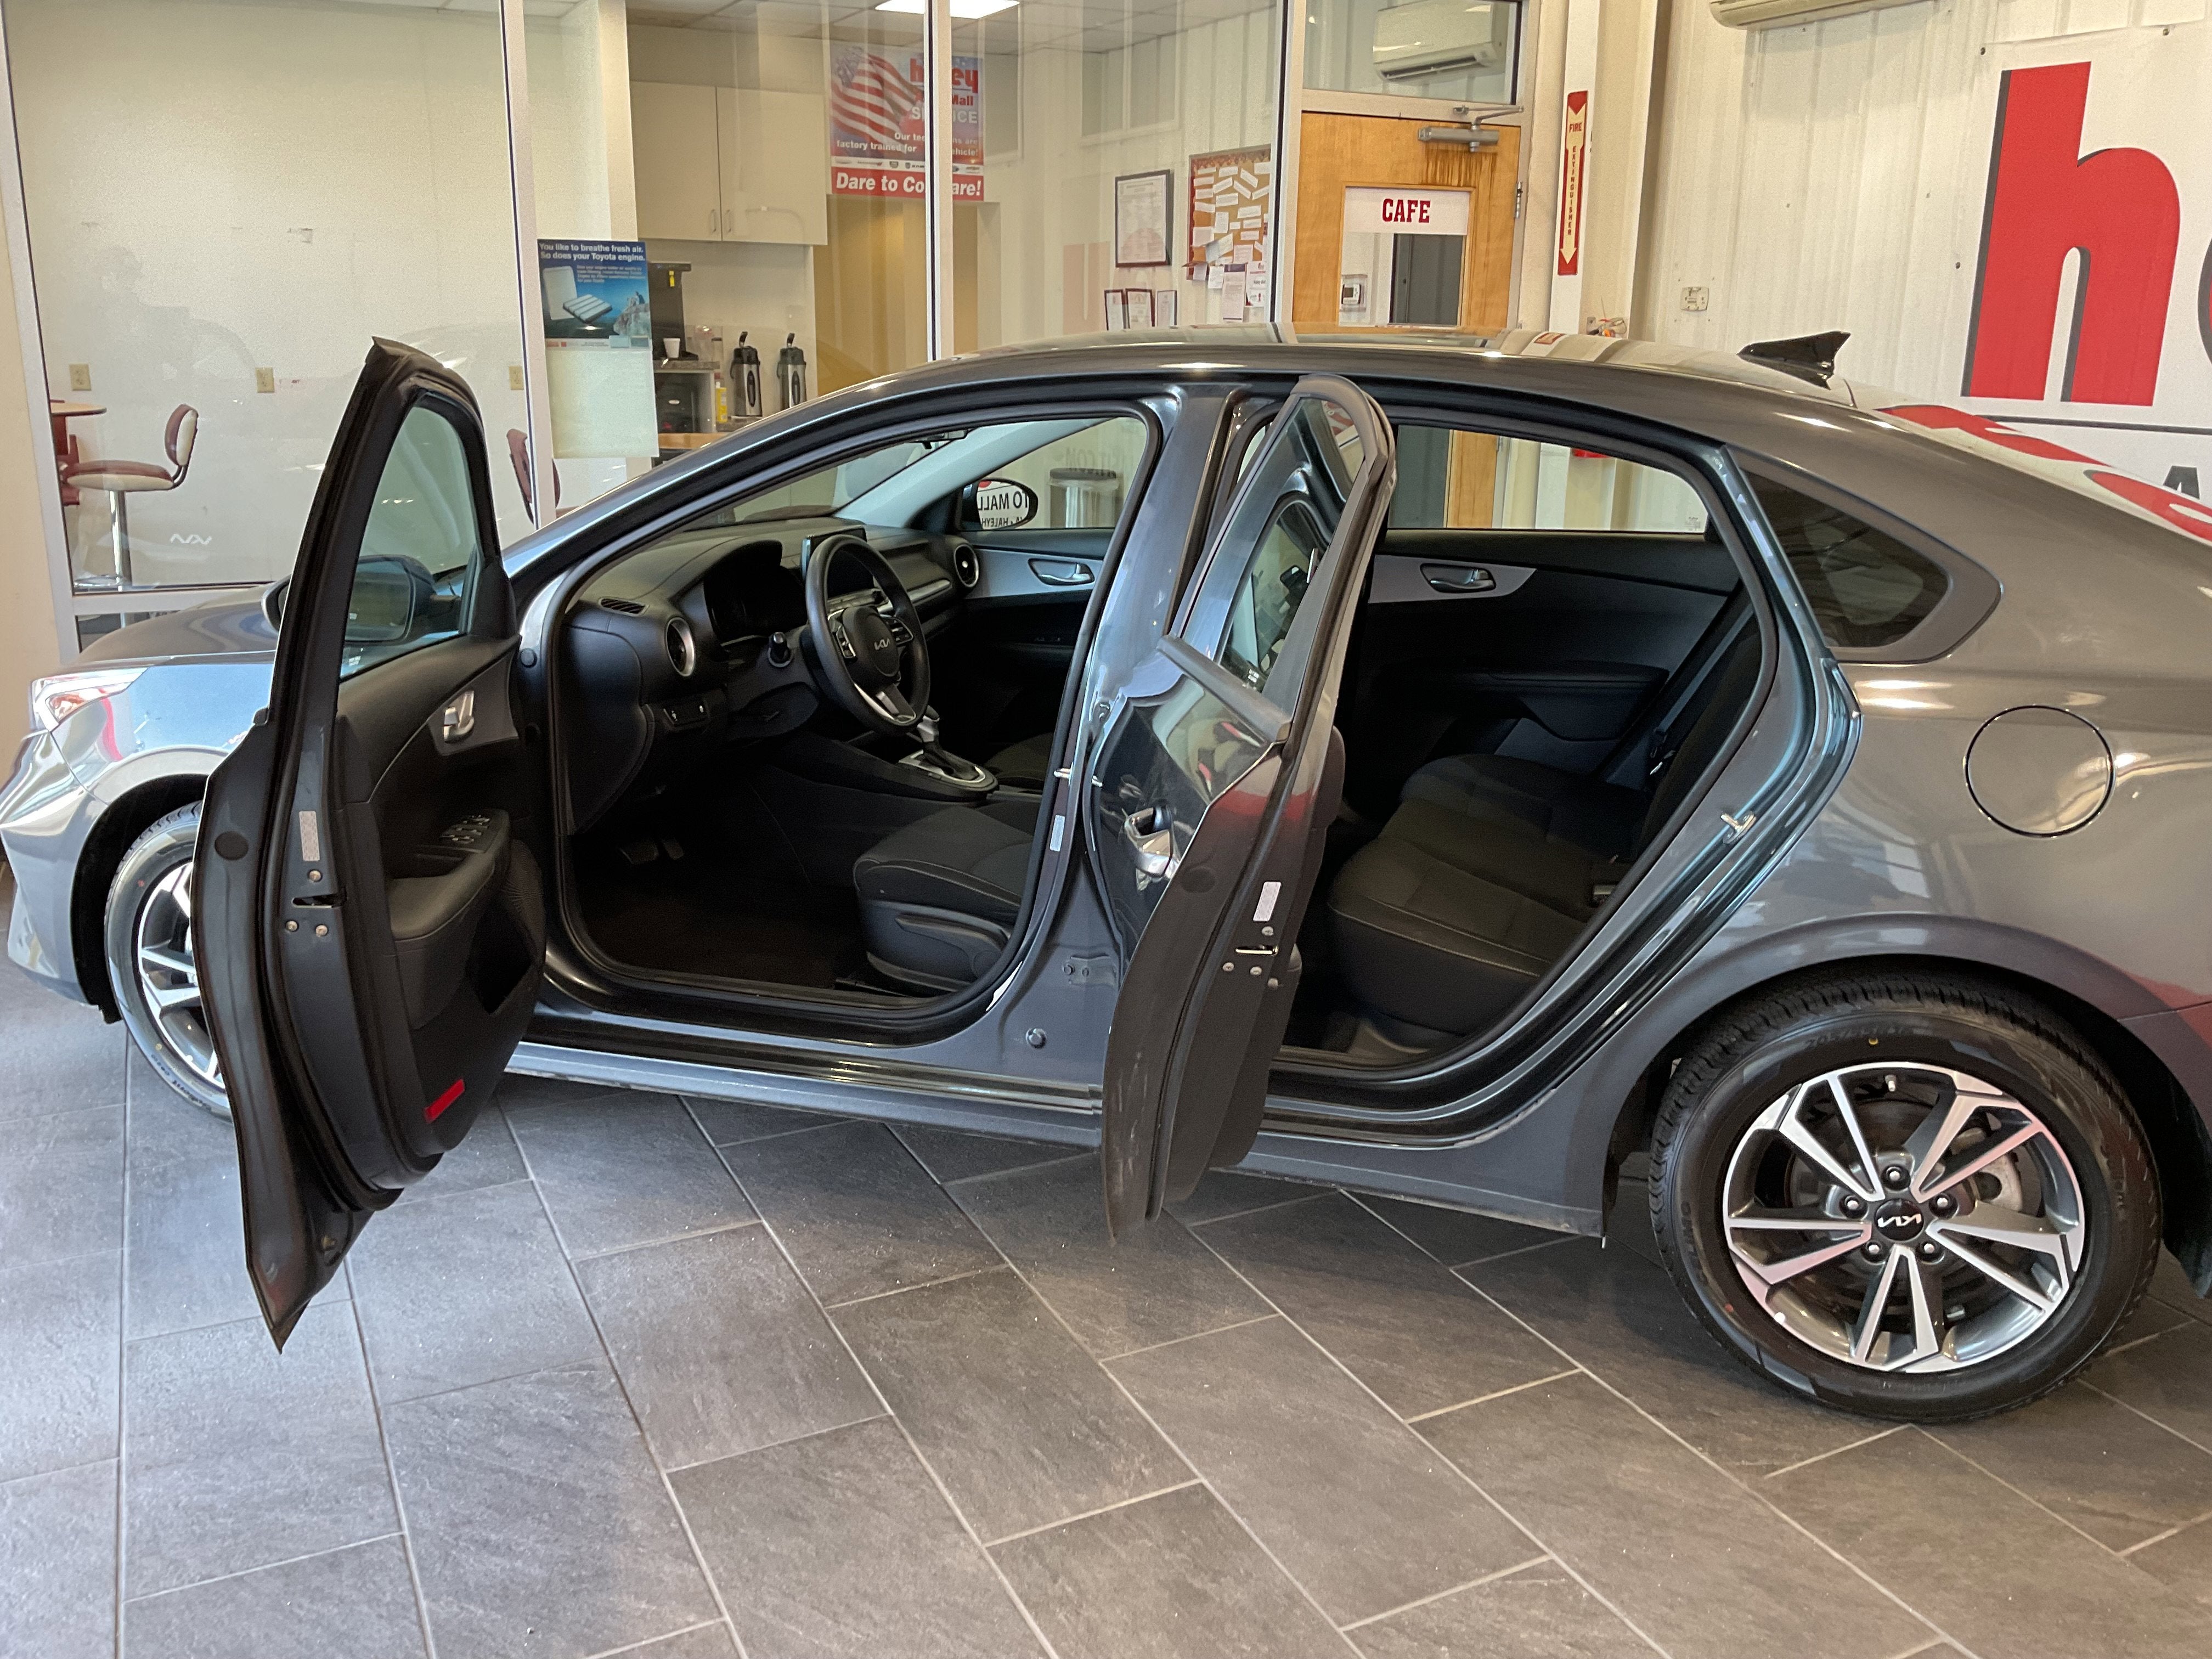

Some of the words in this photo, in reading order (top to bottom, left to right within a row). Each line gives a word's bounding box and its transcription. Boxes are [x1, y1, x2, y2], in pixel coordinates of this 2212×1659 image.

[1568, 122, 1582, 133] FIRE
[894, 132, 911, 140] Our
[837, 140, 868, 150] factory
[870, 143, 901, 152] trained
[904, 144, 917, 153] for
[836, 172, 876, 190] Dare
[881, 175, 898, 191] to
[1567, 145, 1577, 236] EXTINGUISHER
[1382, 198, 1431, 223] CAFE
[1960, 61, 2212, 407] h
[539, 242, 554, 251] You
[580, 244, 610, 252] breathe
[611, 245, 630, 253] fresh
[591, 252, 617, 262] Toyota
[618, 254, 646, 263] engine.
